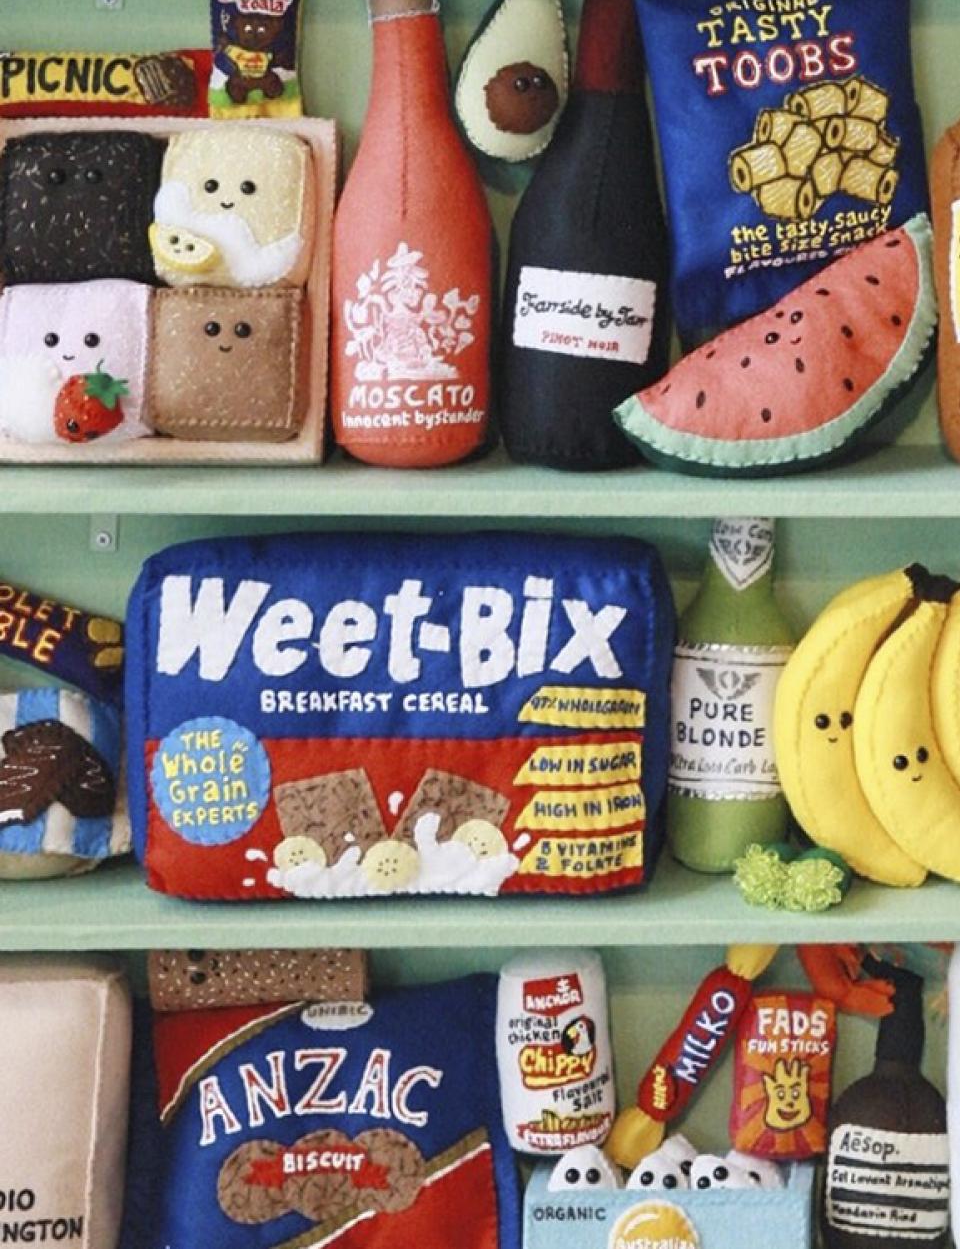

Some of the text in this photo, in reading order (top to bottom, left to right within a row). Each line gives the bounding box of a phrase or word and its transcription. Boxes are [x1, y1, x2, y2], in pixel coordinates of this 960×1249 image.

[697, 5, 832, 47] TASTY
[693, 32, 857, 95] TOOBS
[3, 57, 131, 96] PICNIC
[731, 206, 892, 244] the saucy
[731, 223, 888, 263] bite size snack
[350, 384, 475, 409] MOSCATO
[414, 408, 485, 430] bystander
[155, 575, 628, 687] Weet-Bix
[260, 691, 488, 715] BREAKFAST CEREAL
[690, 698, 753, 722] PURE
[181, 729, 221, 750] THE
[676, 723, 765, 747] BLONDE
[162, 750, 244, 779] Whole
[529, 751, 637, 773] LOW IN SUGAR
[169, 780, 249, 805] Grain
[173, 803, 258, 826] EXPERTS
[534, 794, 641, 817] HIGH IN IRON
[758, 1007, 828, 1037] FADS
[677, 989, 736, 1084] MILKO
[781, 1040, 830, 1055] STICKS
[520, 1047, 594, 1076] Chippy
[199, 1048, 443, 1147] ANZAC
[283, 1152, 365, 1173] BISCUIT
[533, 1208, 606, 1221] ORGANIC
